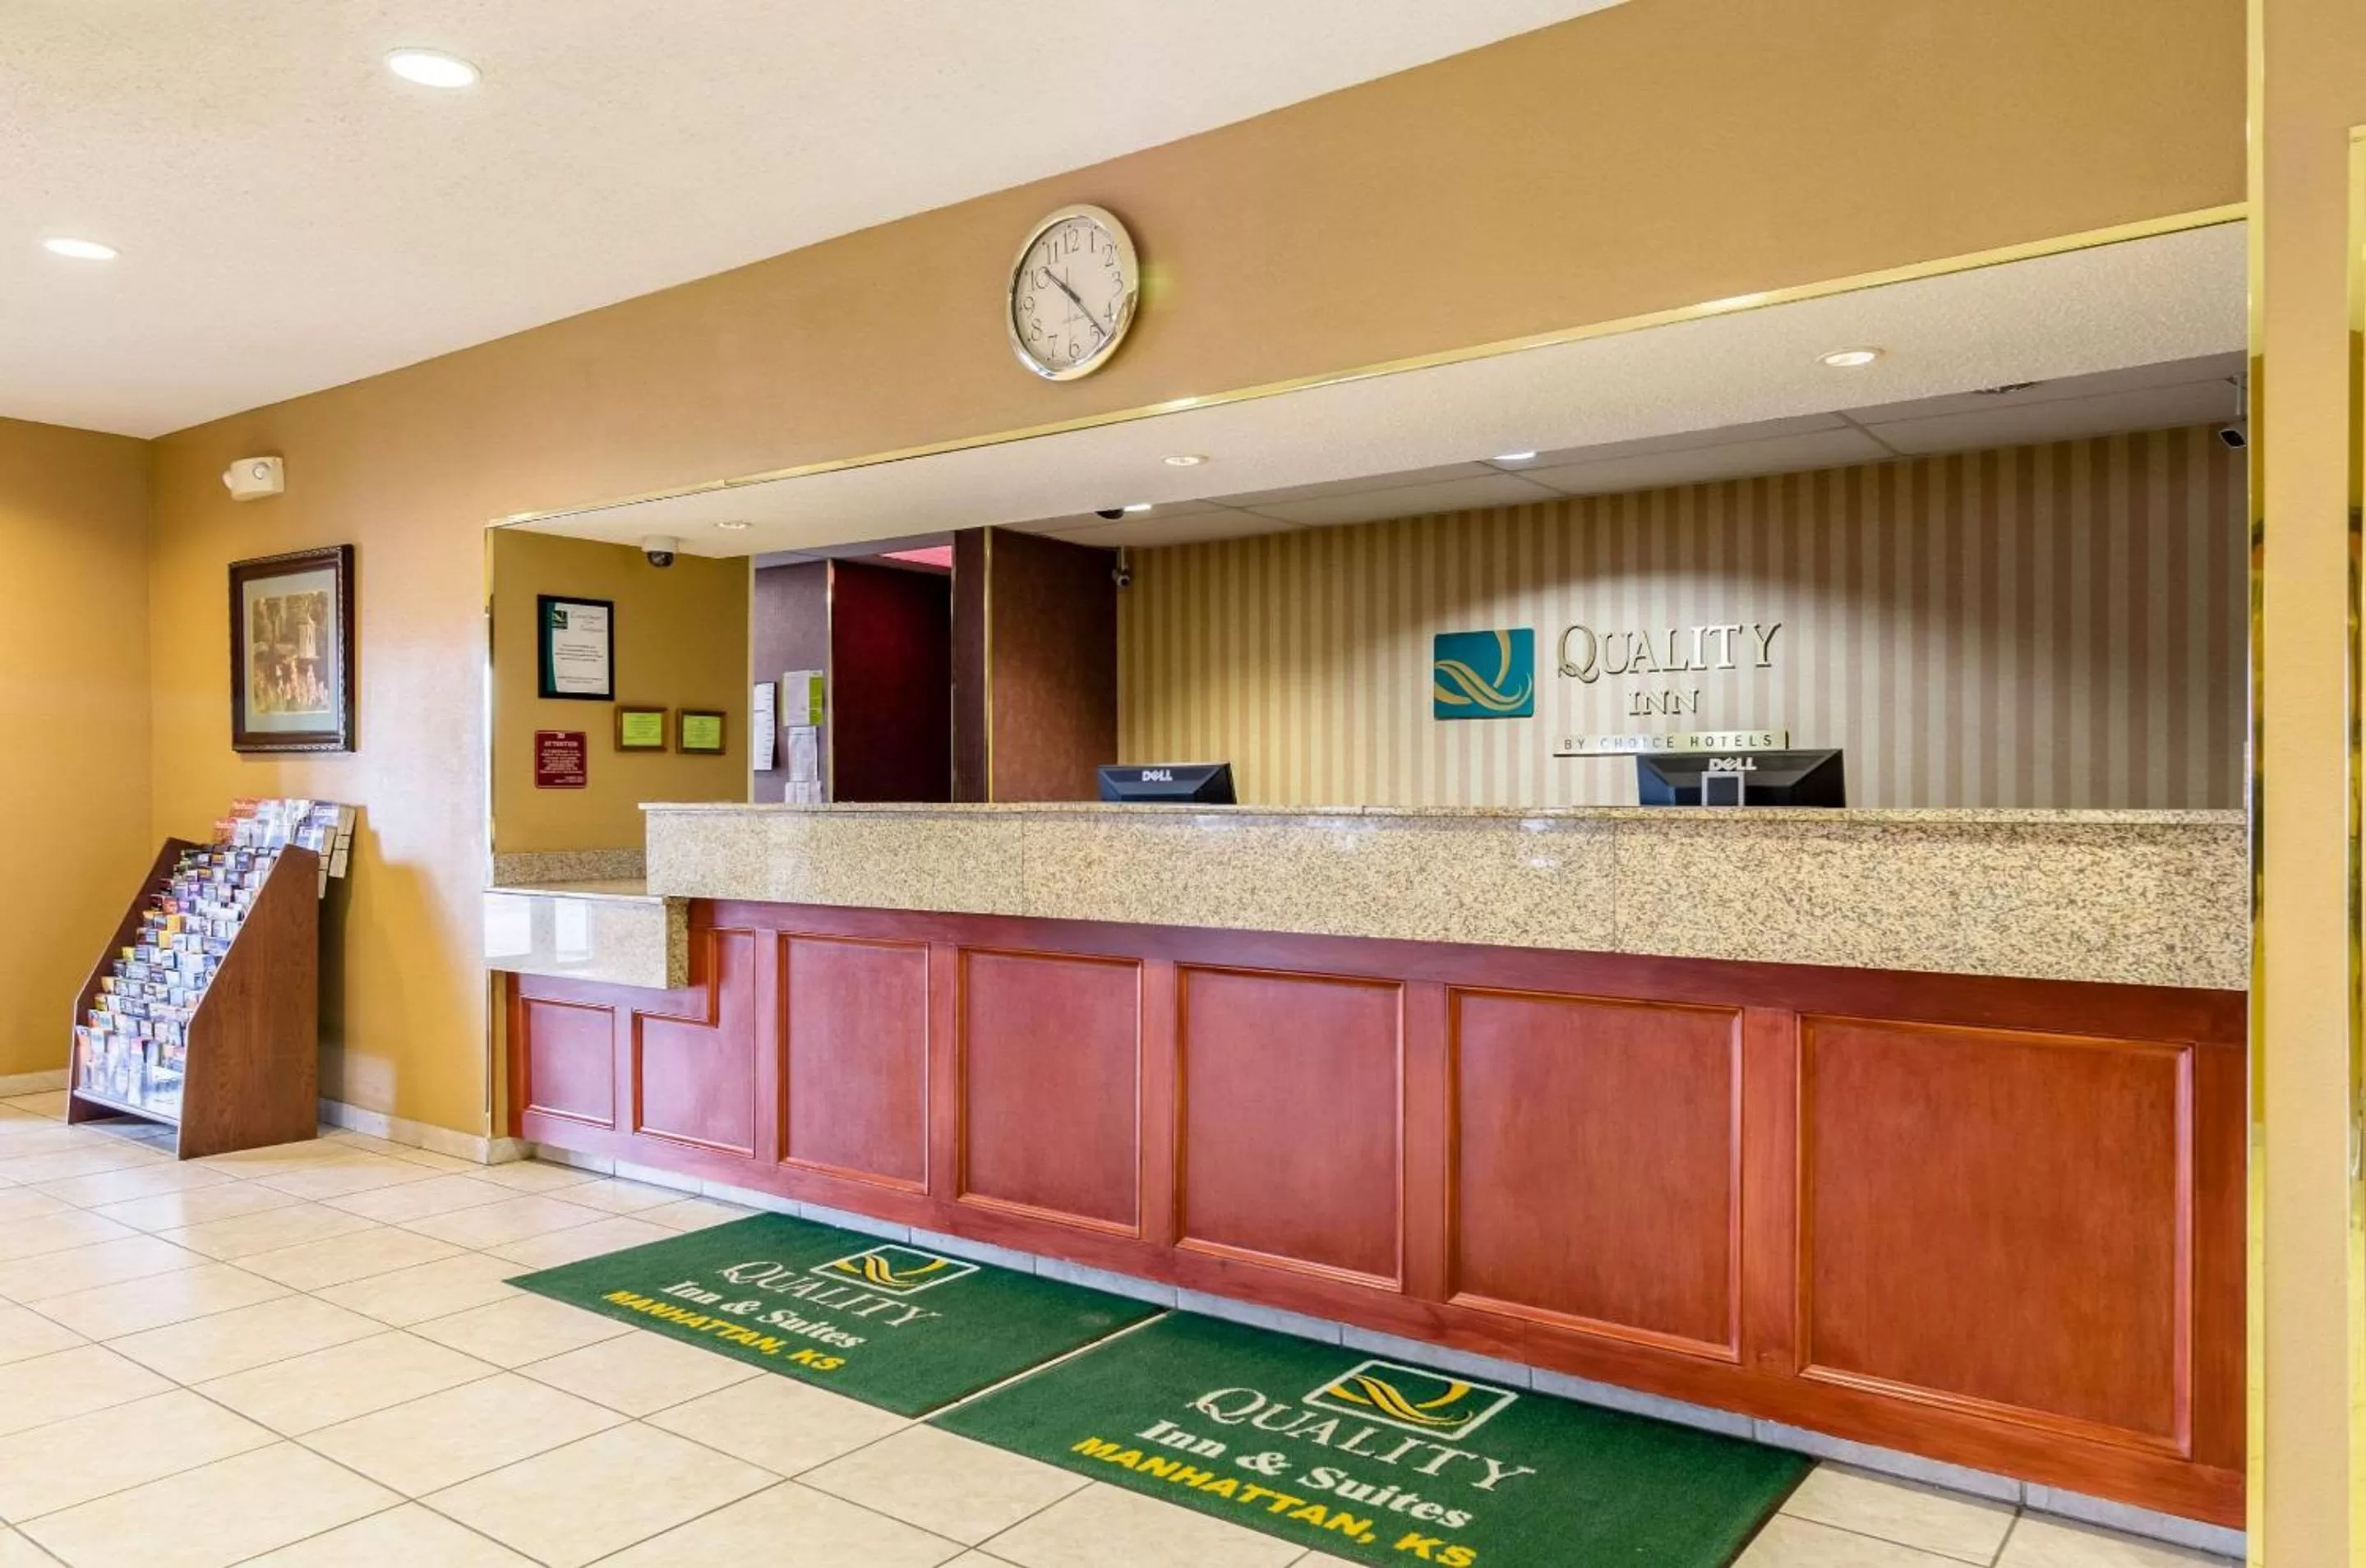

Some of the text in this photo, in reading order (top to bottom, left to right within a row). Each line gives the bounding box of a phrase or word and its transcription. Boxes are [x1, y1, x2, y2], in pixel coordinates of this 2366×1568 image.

[1047, 241, 1058, 265] 11
[1063, 228, 1079, 254] 12
[1102, 244, 1114, 267] 2
[1031, 265, 1049, 291] 10
[1111, 271, 1123, 297] 3
[1031, 318, 1042, 341] 8
[1048, 334, 1058, 357] 7
[1557, 621, 1783, 684] QUALITY
[1628, 689, 1700, 716] INN
[1564, 739, 1586, 749] BY
[1690, 735, 1773, 747] HOTELS
[1141, 770, 1173, 782] DELL
[1708, 757, 1757, 771] DELL
[715, 1261, 943, 1328] QUALITY
[659, 1280, 869, 1349] Inn & Suites
[602, 1289, 847, 1371] MANHATTAN, KS
[1184, 1386, 1538, 1492] QUALITY
[1135, 1419, 1474, 1529] Inn & Suites
[1069, 1436, 1479, 1568] MANHATTAN, KS
